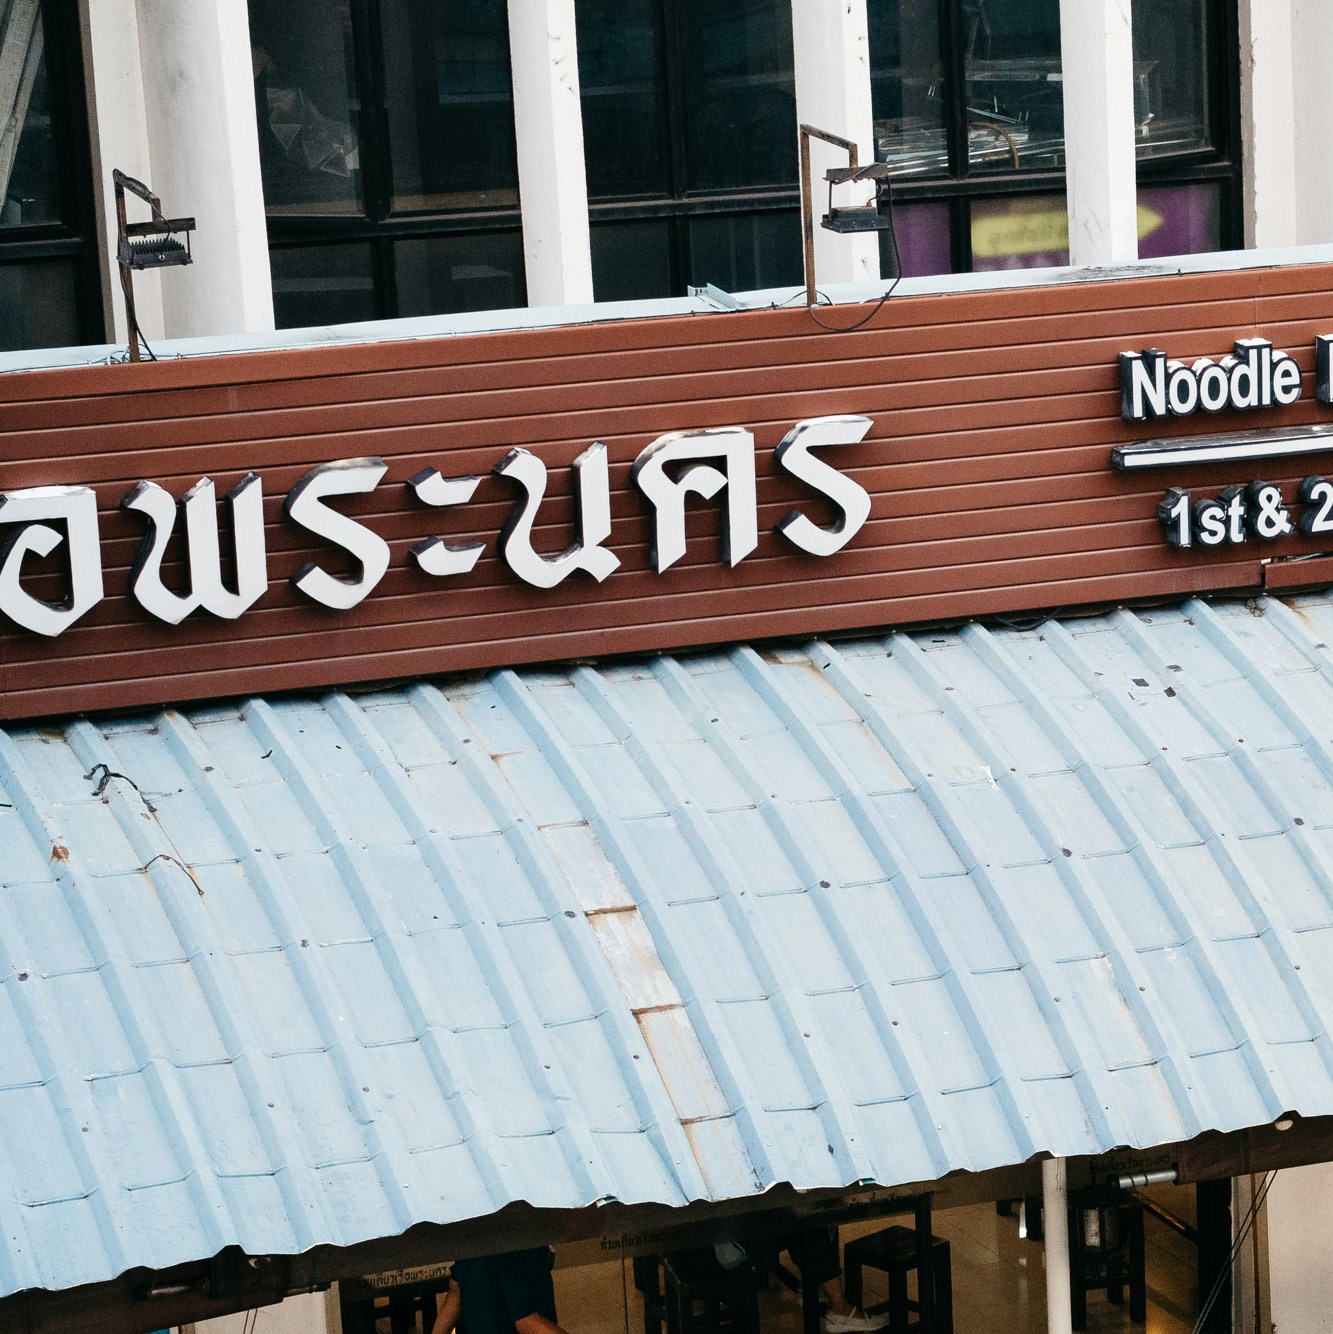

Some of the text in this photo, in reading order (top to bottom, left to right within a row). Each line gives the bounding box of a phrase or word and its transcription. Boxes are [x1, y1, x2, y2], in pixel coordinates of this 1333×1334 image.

[1125, 338, 1302, 420] Noodle
[1164, 491, 1246, 547] 1st
[1253, 482, 1292, 540] &
